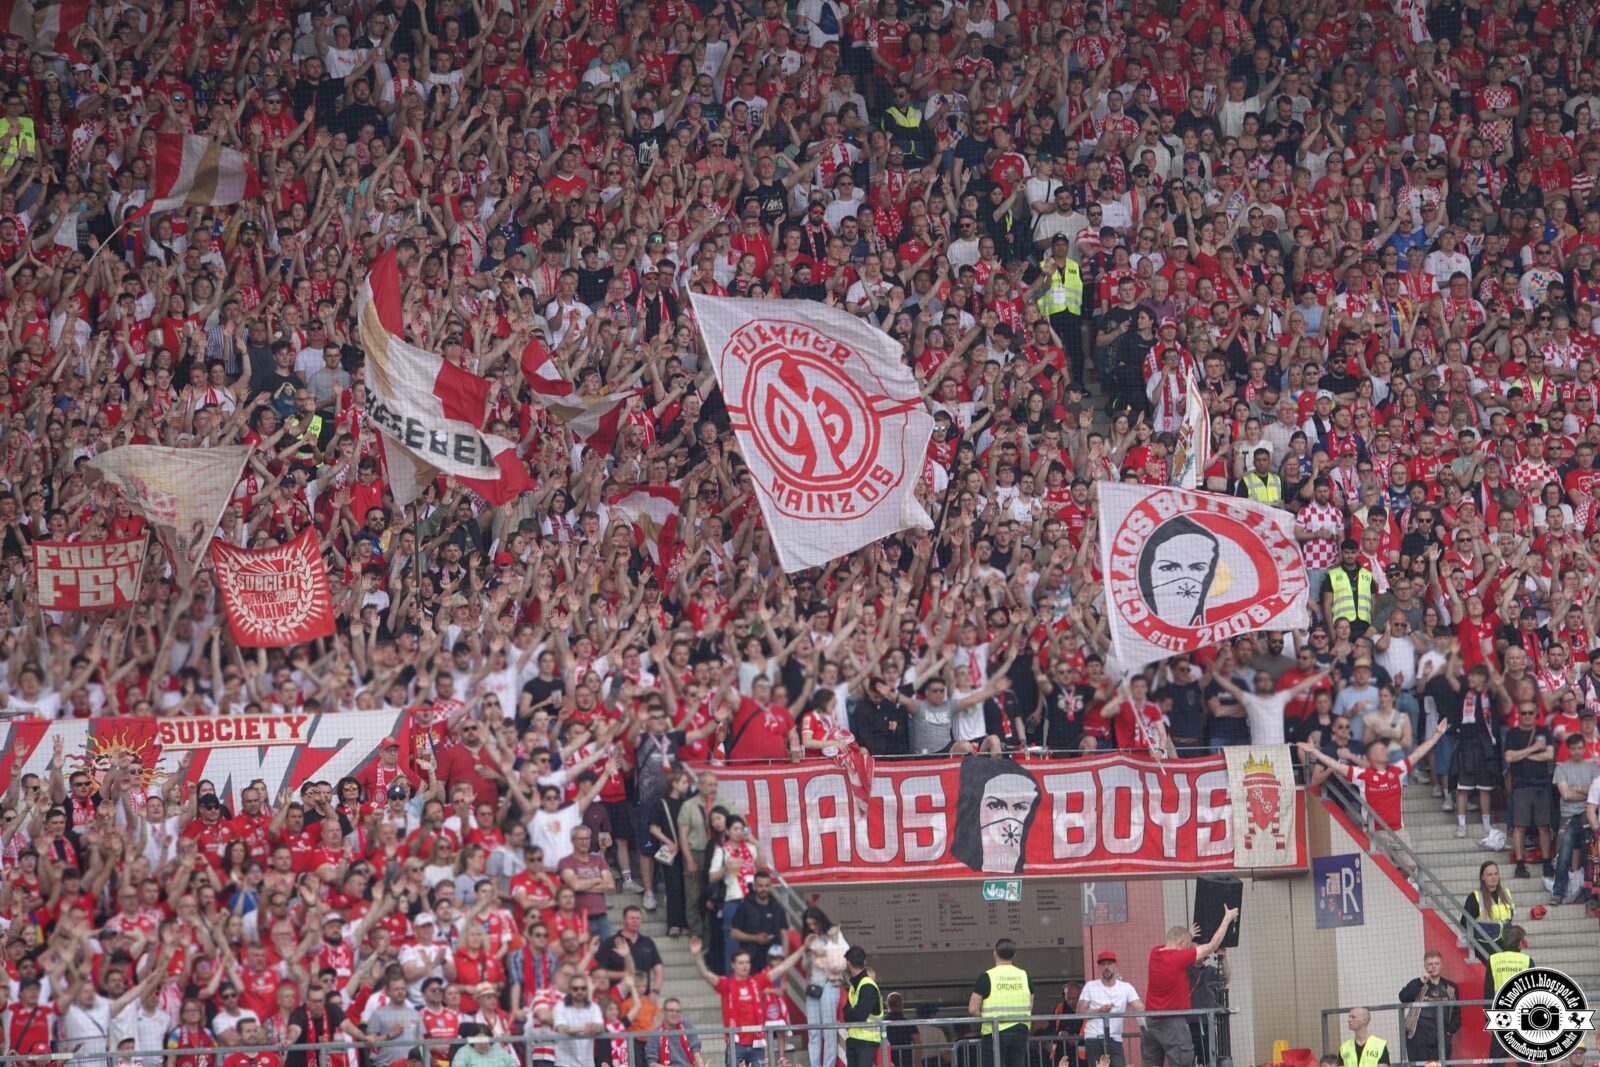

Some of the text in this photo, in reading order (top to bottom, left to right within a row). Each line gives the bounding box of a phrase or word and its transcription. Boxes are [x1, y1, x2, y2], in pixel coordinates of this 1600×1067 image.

[771, 476, 856, 514] MAINZ
[37, 562, 141, 608] FSV
[236, 571, 299, 592] SUBCIETY
[1111, 510, 1155, 624] CHAOS
[1148, 604, 1271, 652] SEIT 2008
[159, 715, 308, 745] SUBCIETY
[1044, 764, 1235, 860] BOYS
[996, 983, 1024, 991] ORDNER
